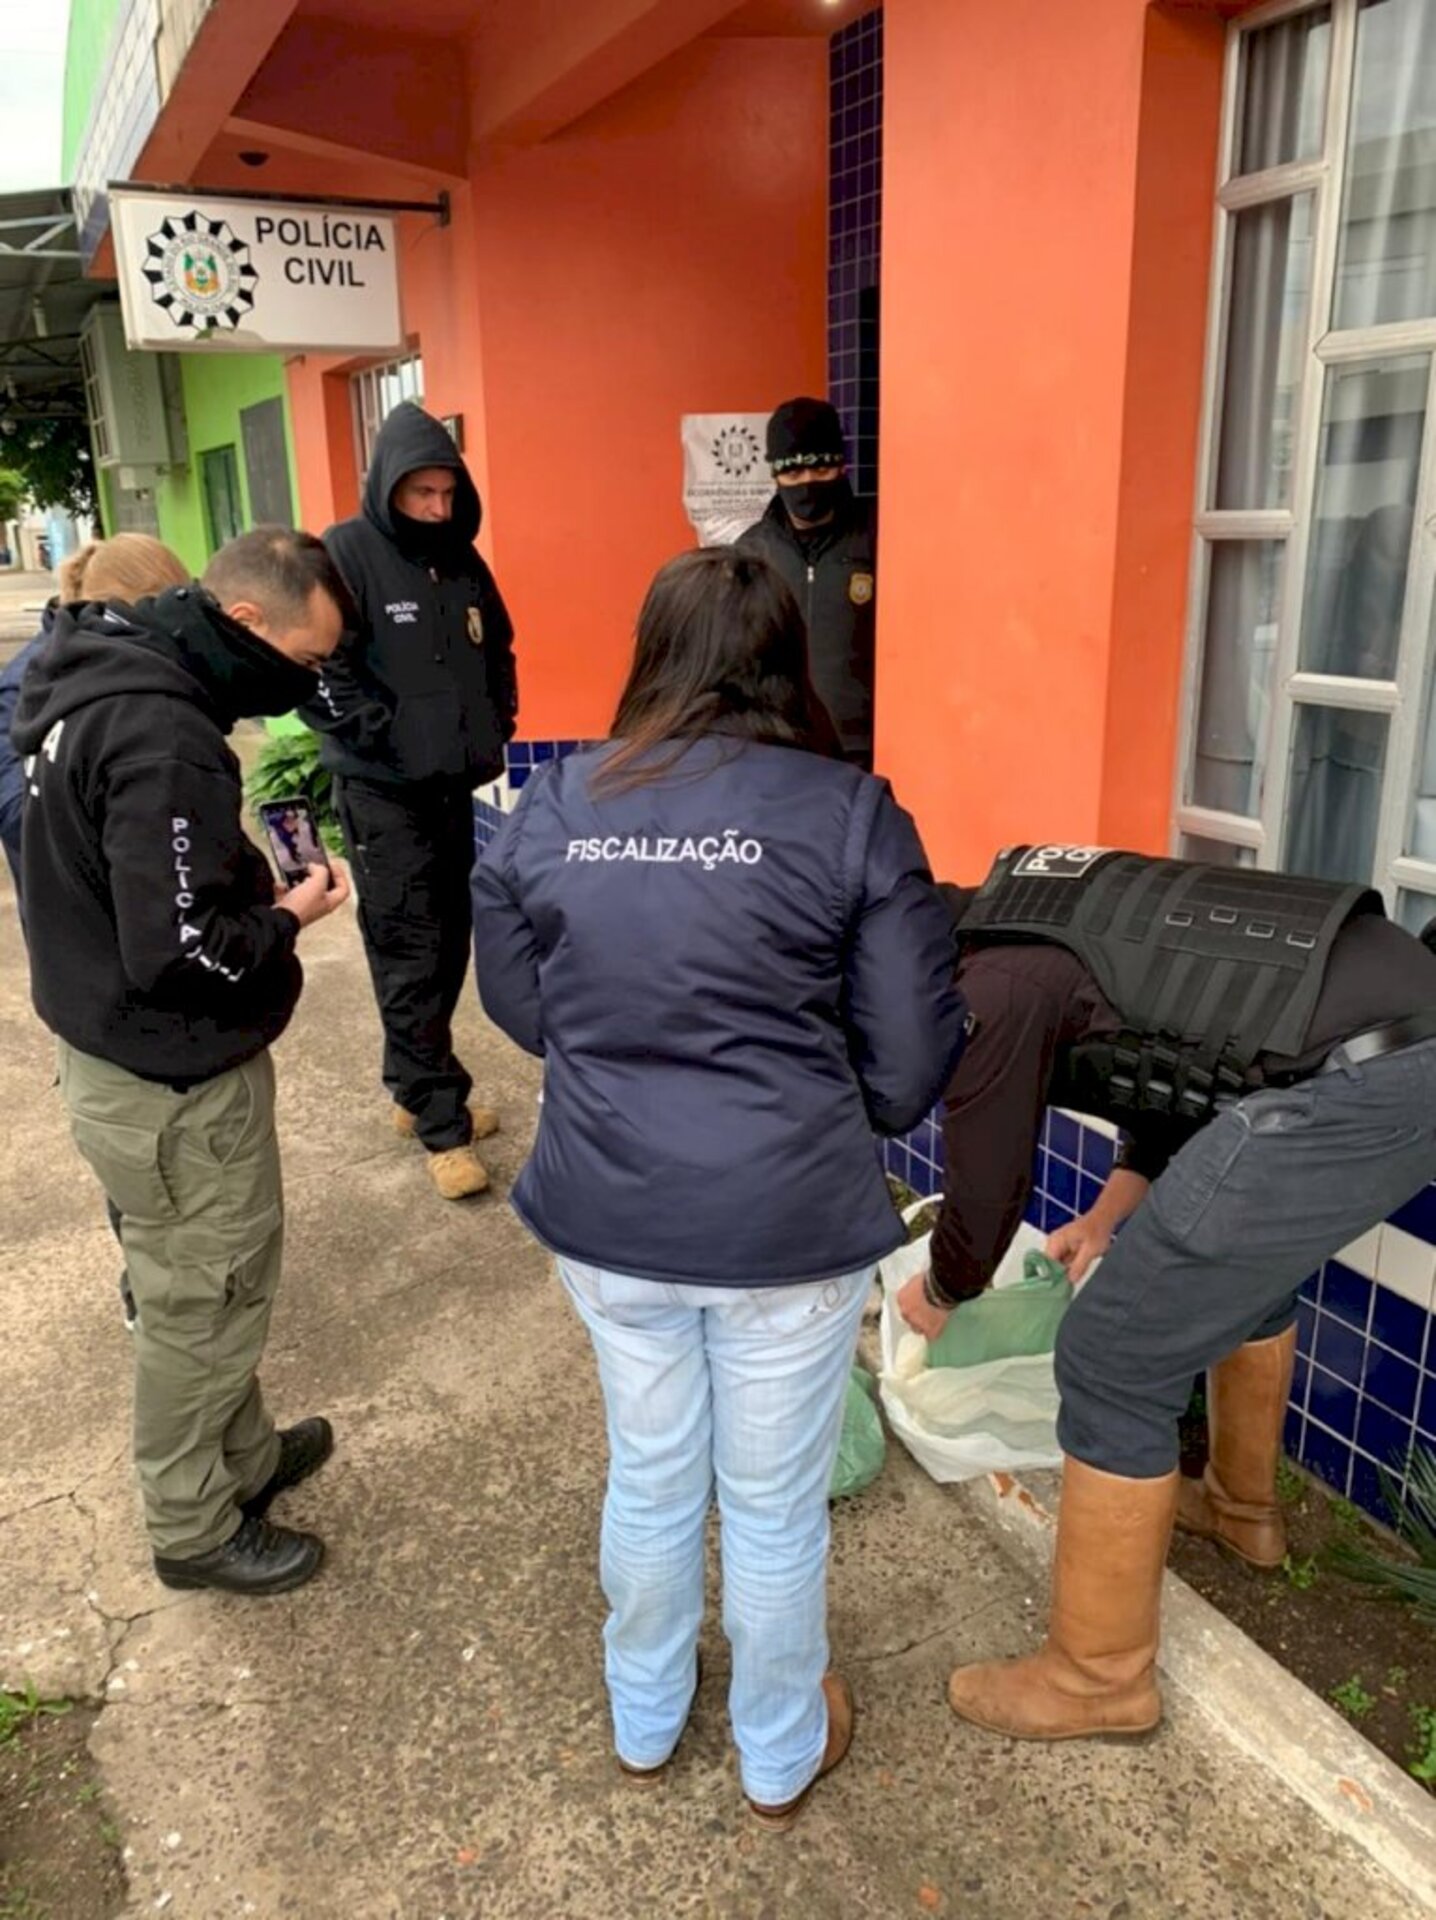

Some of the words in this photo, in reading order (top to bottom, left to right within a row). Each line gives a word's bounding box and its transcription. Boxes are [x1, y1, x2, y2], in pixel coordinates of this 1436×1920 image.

[255, 215, 385, 252] POLÍCIA
[284, 257, 366, 288] CIVIL
[565, 829, 763, 871] FISCALIZAÇÃO
